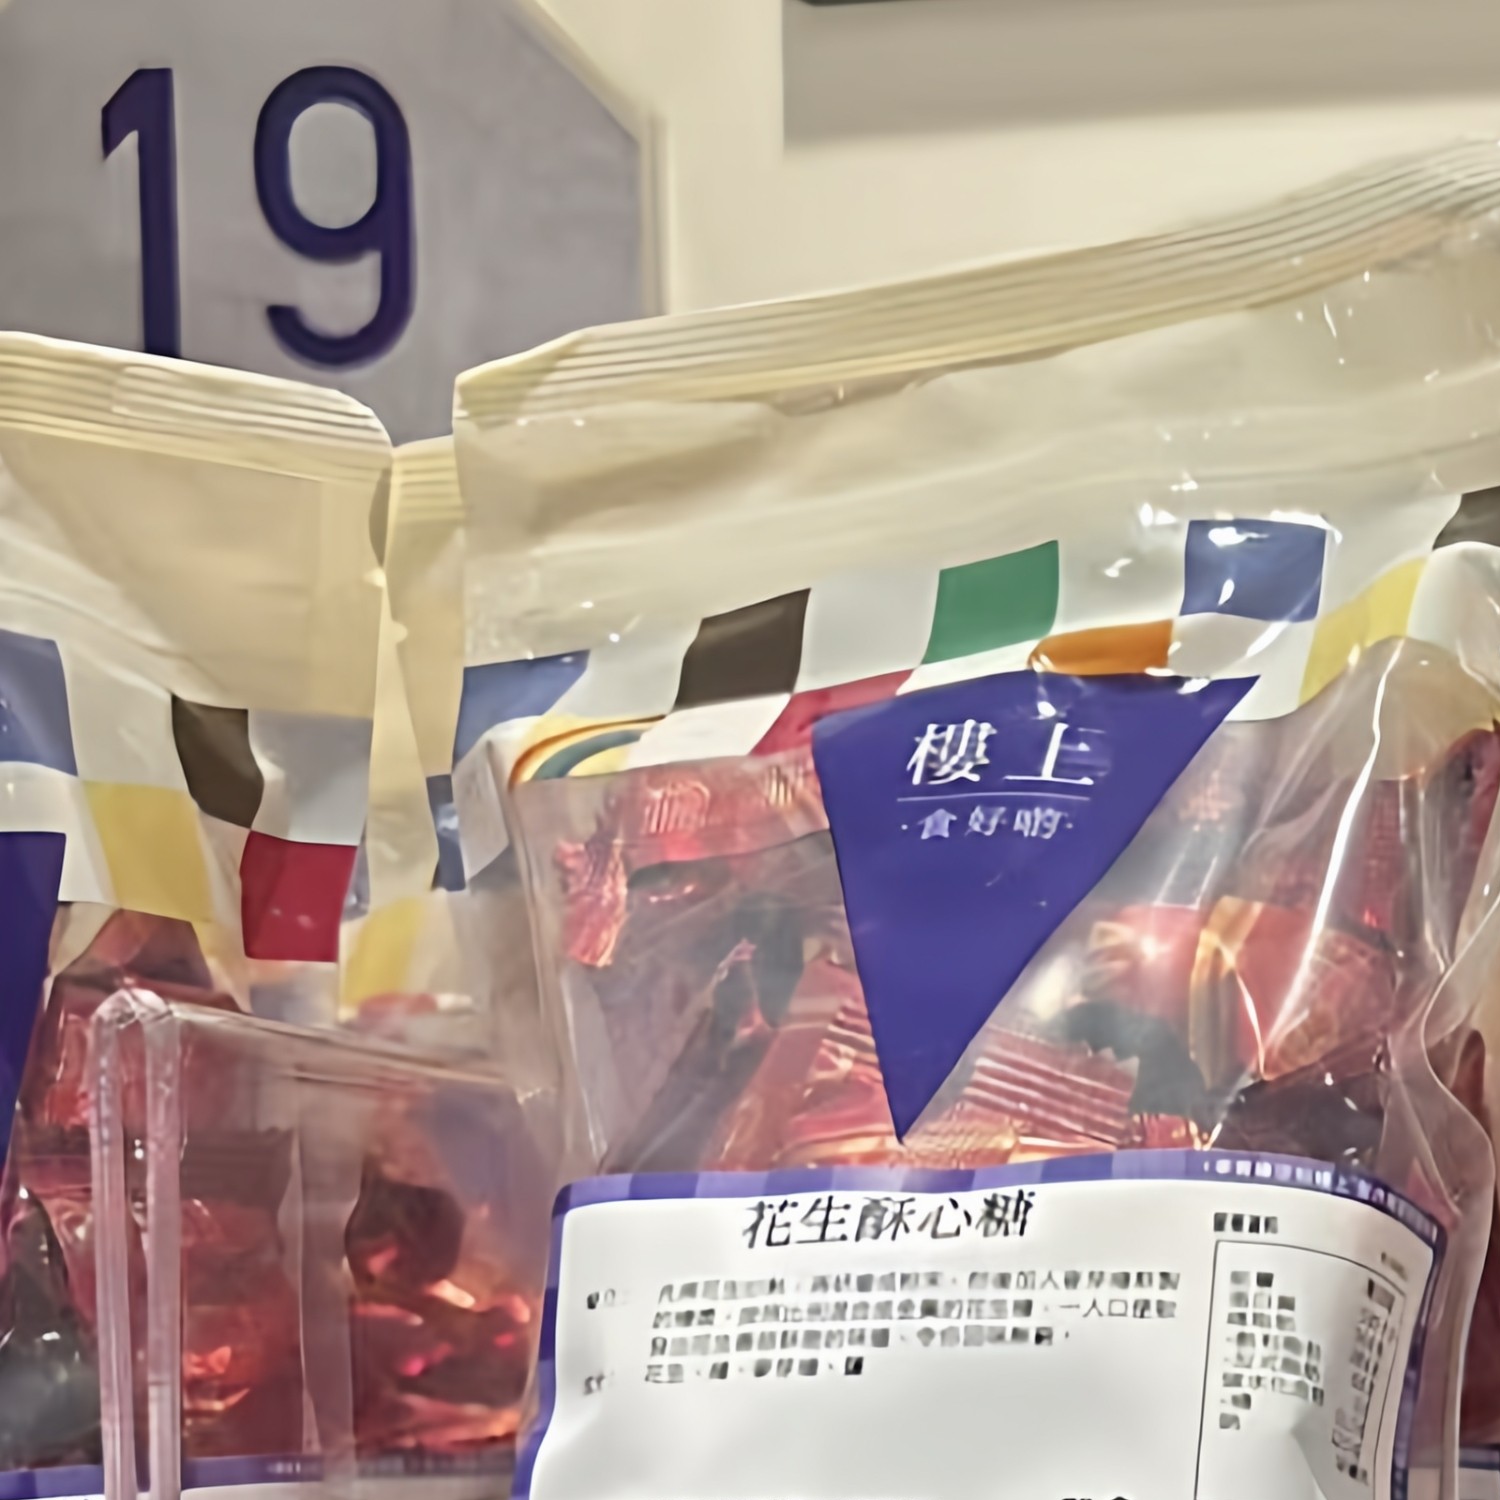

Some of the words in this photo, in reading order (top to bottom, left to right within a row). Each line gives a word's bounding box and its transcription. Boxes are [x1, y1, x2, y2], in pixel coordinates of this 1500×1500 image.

[101, 64, 417, 369] 19
[906, 718, 1098, 785] 樓上
[742, 1189, 1037, 1249] 花生酥心糖
